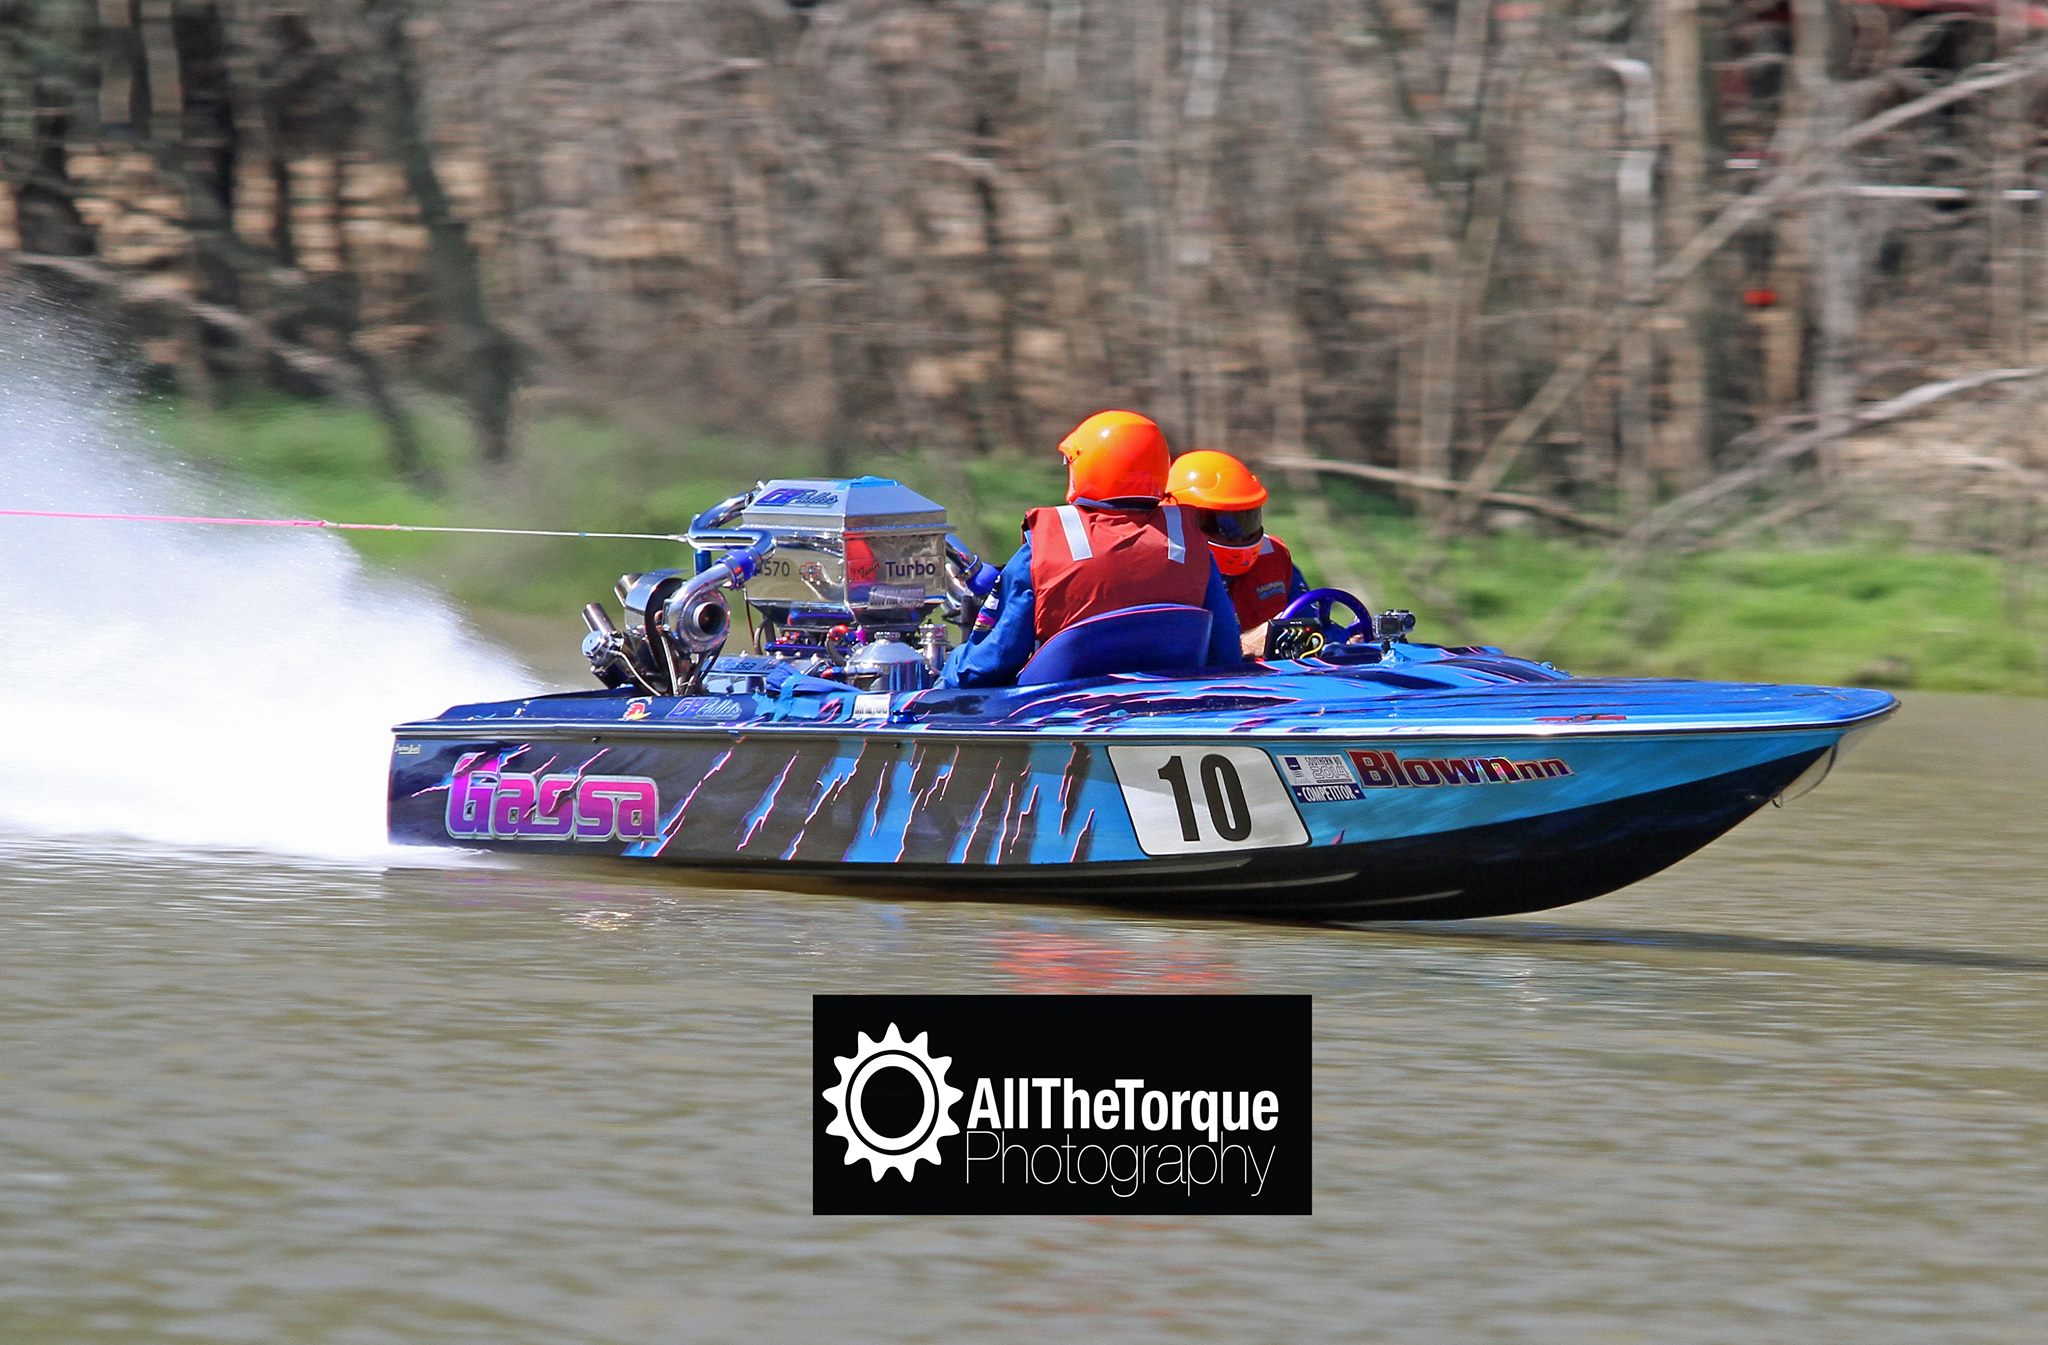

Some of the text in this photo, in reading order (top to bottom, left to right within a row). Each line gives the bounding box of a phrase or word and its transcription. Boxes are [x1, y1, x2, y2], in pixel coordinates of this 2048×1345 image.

[885, 560, 936, 577] Turbo
[1310, 766, 1350, 779] 2014
[446, 752, 661, 842] Gassa
[1157, 753, 1252, 842] 10
[1301, 785, 1357, 802] COMPETITOR
